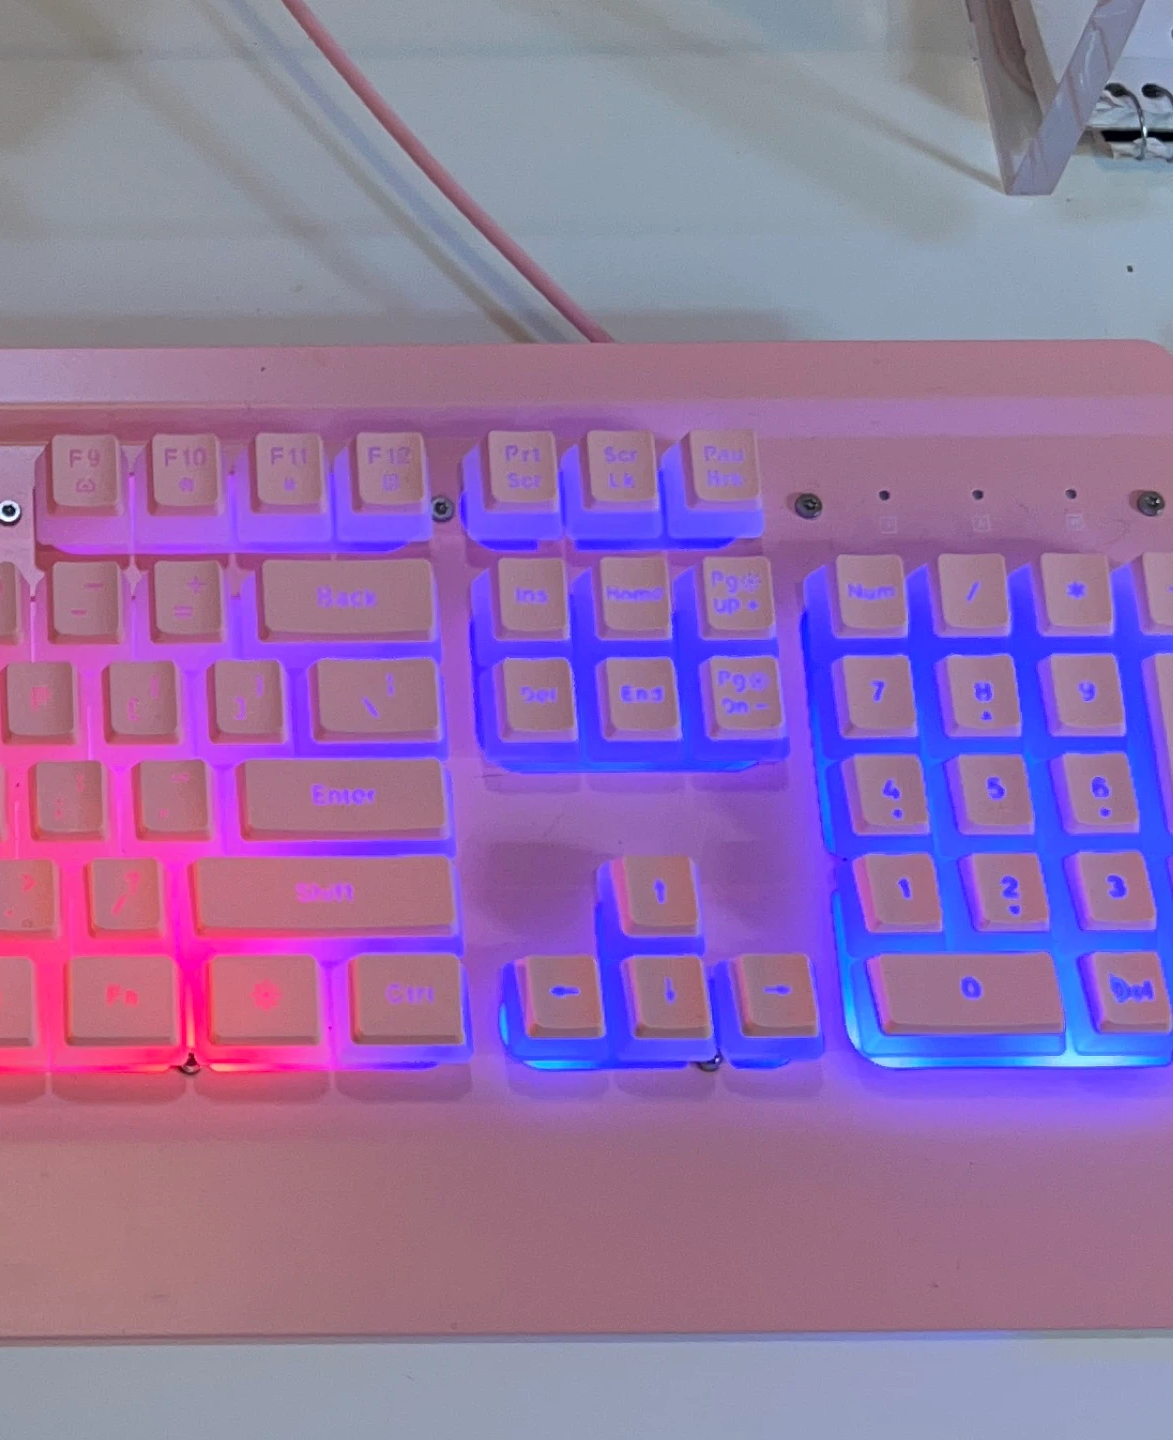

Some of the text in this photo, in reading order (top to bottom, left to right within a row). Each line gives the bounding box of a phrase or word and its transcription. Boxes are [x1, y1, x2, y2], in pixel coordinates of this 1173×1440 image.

[68, 448, 100, 469] F9
[163, 447, 207, 468] F10
[269, 446, 309, 467] F11
[871, 679, 887, 702] 7
[882, 778, 901, 801] 4
[987, 776, 1006, 800] 5
[1091, 776, 1110, 799] 6
[897, 876, 913, 900] 1
[999, 874, 1020, 899] 2
[1105, 874, 1127, 899] 3
[960, 975, 983, 1000] 0
